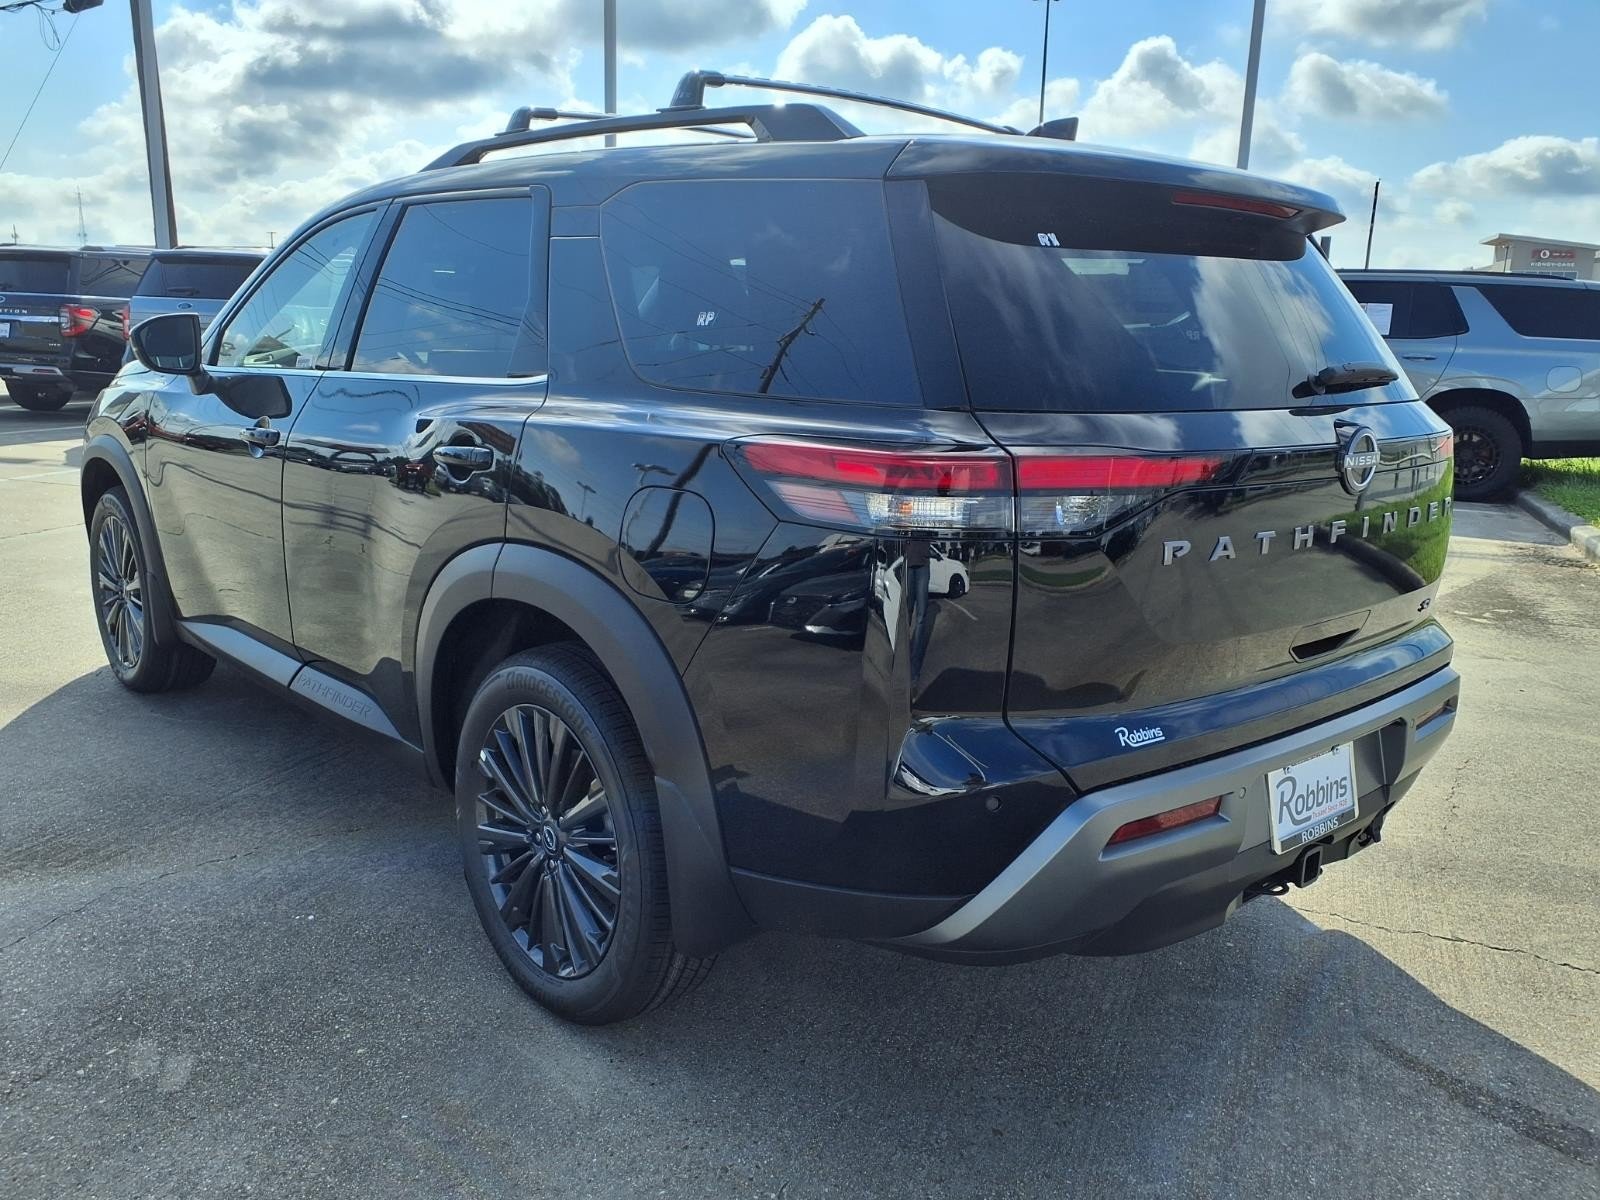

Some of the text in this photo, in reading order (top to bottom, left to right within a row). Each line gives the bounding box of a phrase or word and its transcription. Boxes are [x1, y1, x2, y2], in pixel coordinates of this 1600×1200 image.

[1162, 496, 1452, 566] PATHFINDER
[298, 673, 371, 719] PATHFINDER
[1114, 726, 1165, 747] Robbins
[1276, 776, 1347, 826] Robbins
[1301, 817, 1339, 843] ROBBINS
